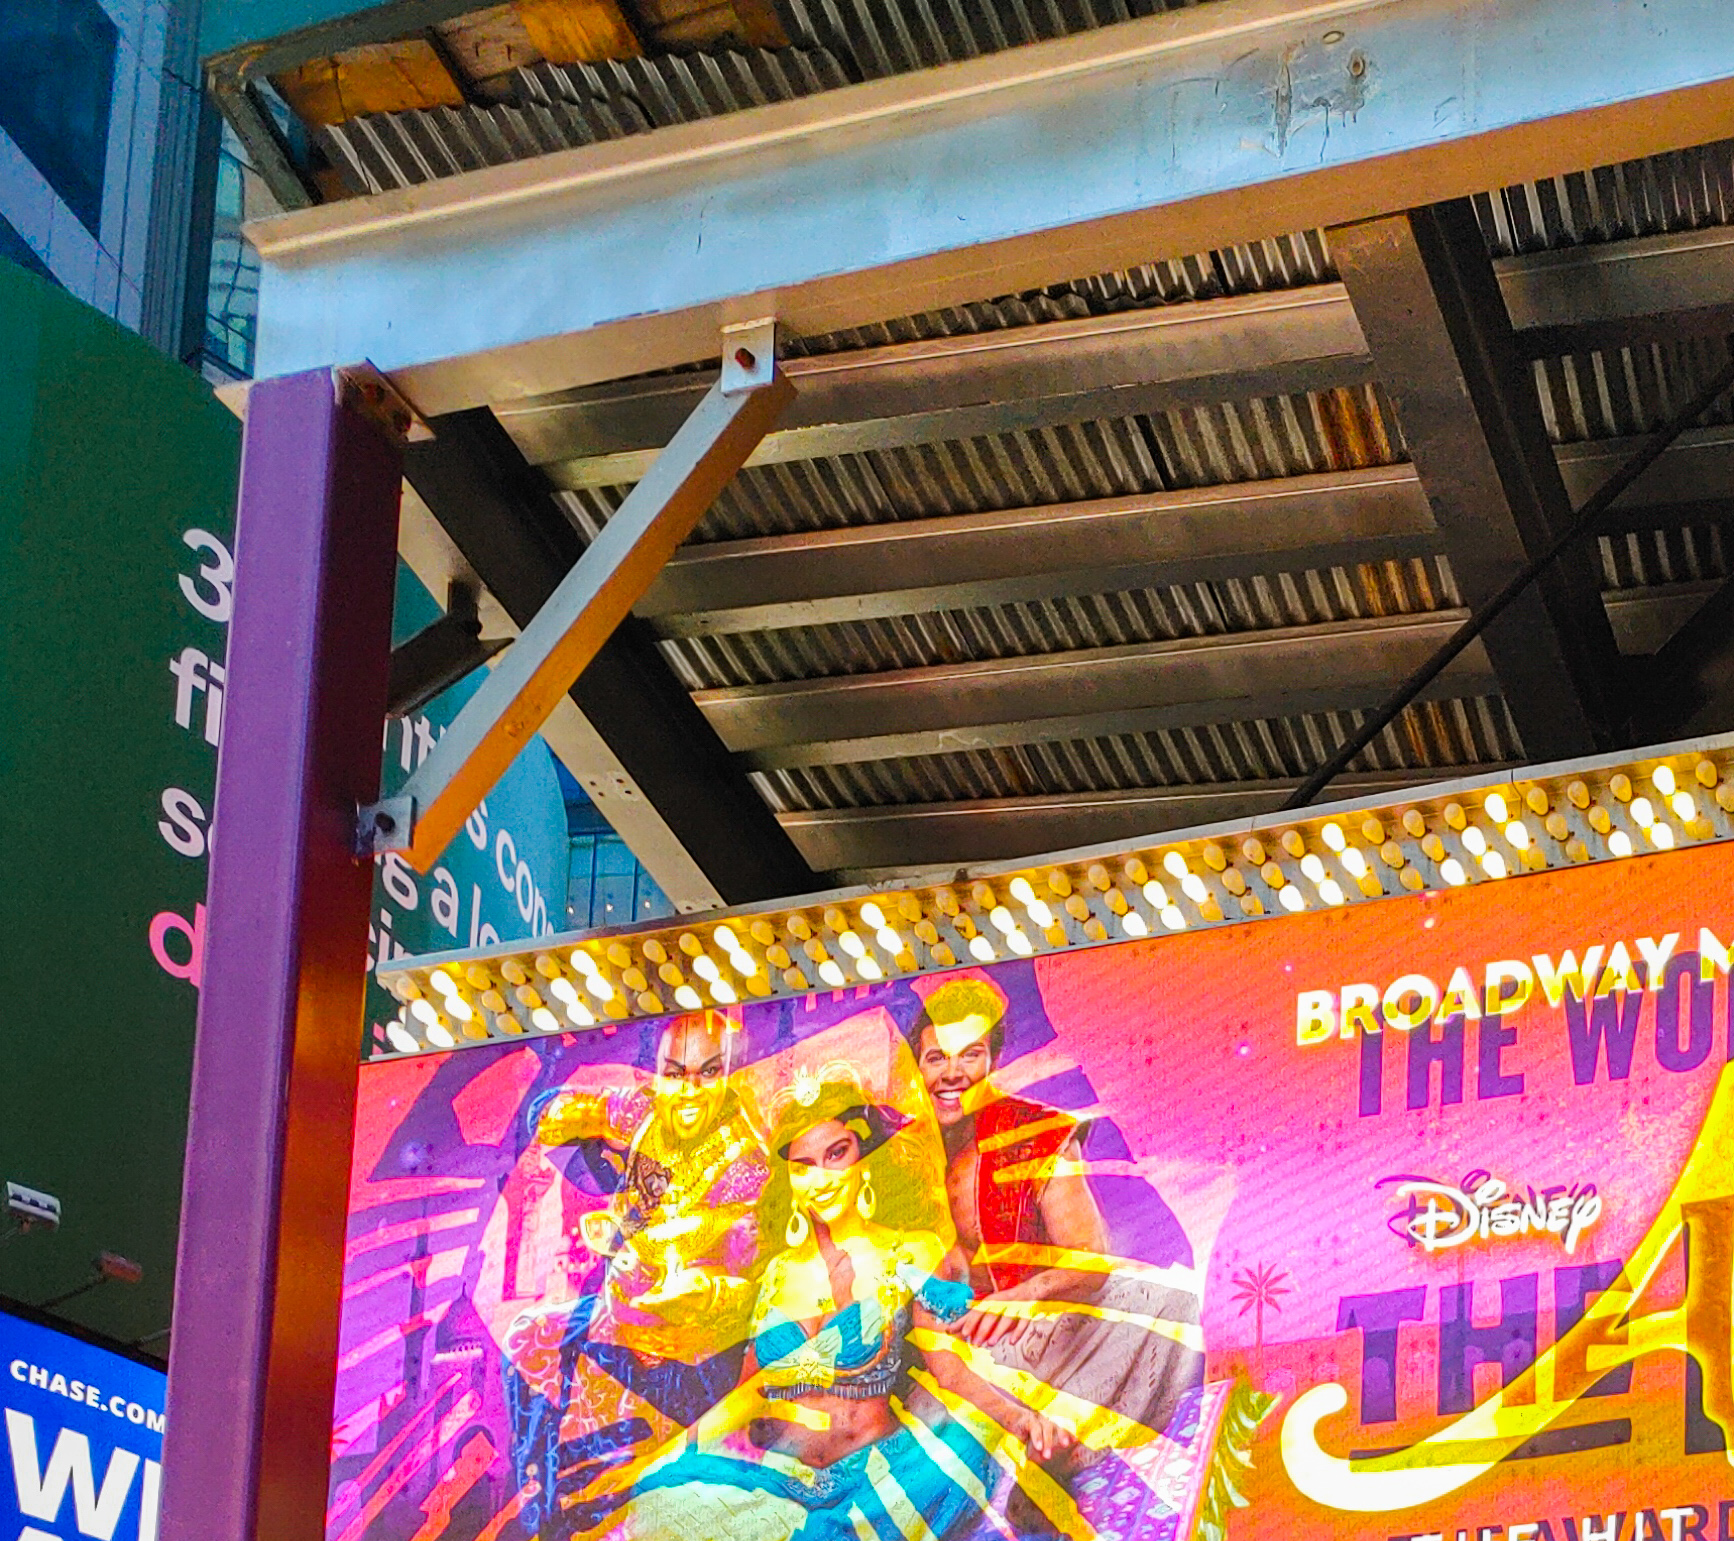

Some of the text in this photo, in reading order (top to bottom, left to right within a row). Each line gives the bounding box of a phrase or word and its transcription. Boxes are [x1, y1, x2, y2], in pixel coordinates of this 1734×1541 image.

[1296, 931, 1680, 1046] BROADWAY
[1345, 985, 1526, 1119] THE
[9, 1359, 166, 1435] CHASE.COM
[1336, 1257, 1633, 1426] THE
